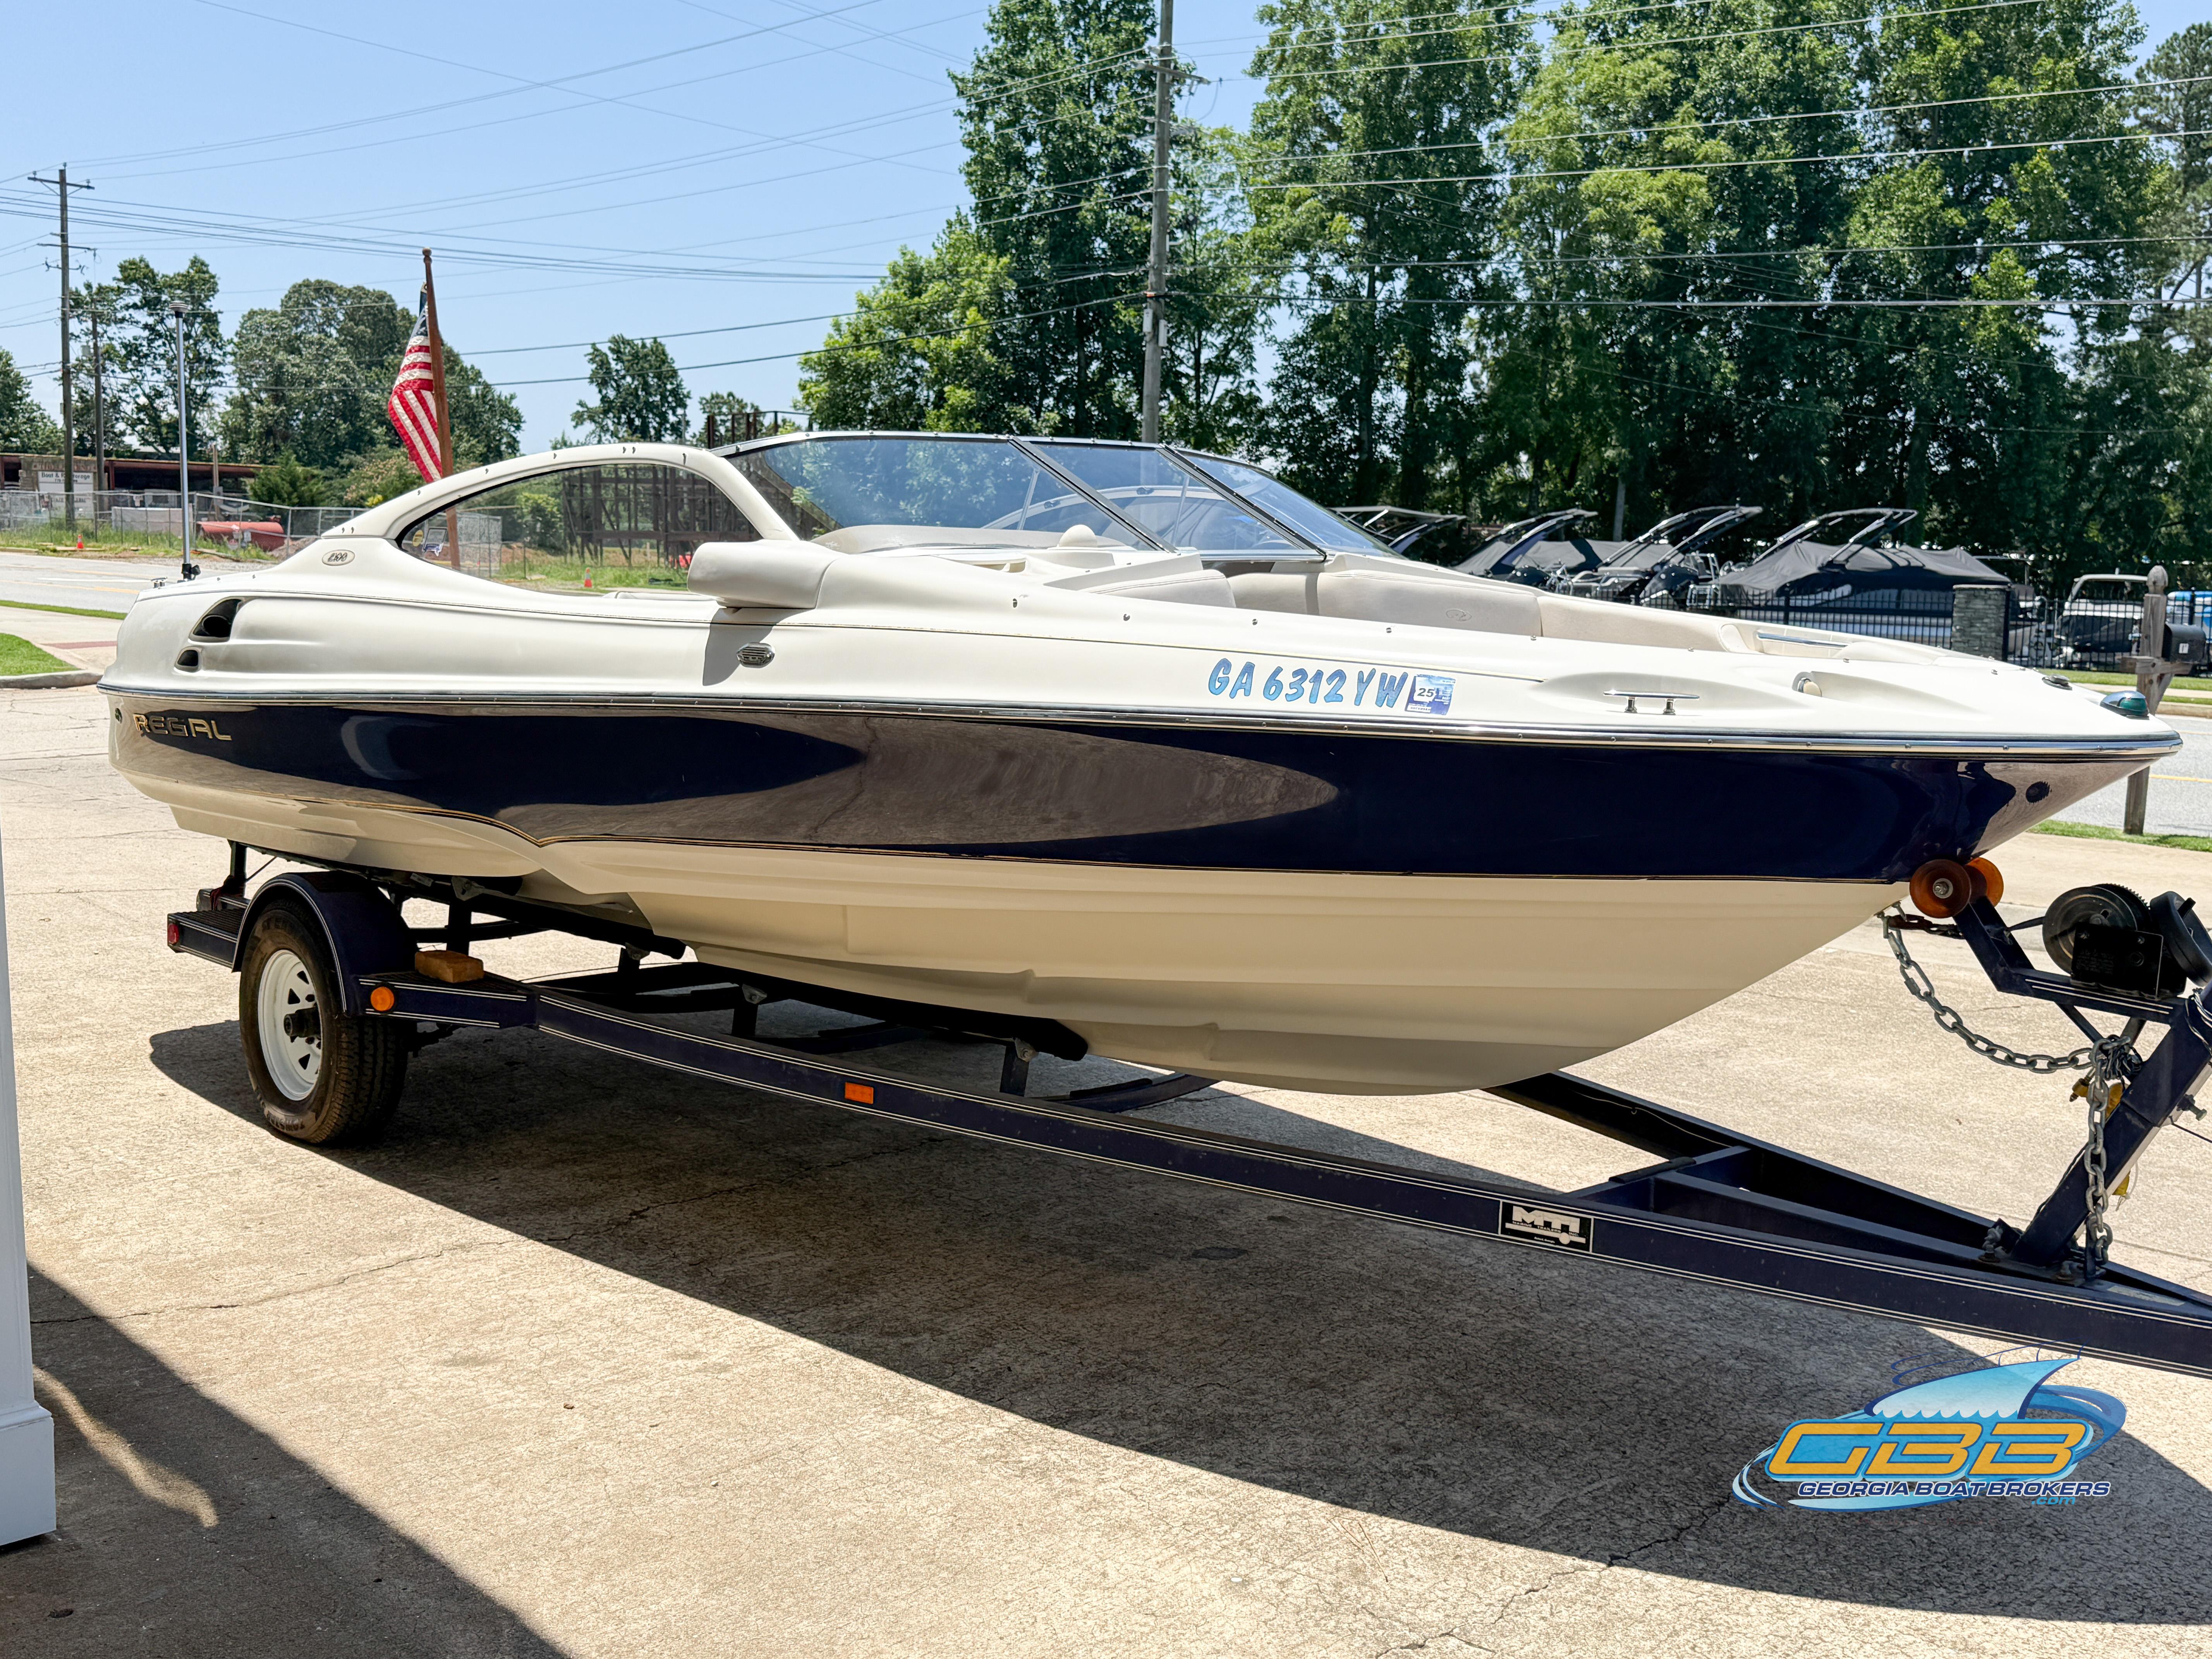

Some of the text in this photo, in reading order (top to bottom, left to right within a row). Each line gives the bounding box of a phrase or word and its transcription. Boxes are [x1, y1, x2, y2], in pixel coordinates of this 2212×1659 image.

[1208, 658, 1255, 699] GA
[1263, 666, 1347, 704] 6312
[1354, 668, 1408, 708] YW
[1417, 688, 1435, 697] 25
[132, 713, 232, 740] REGAL
